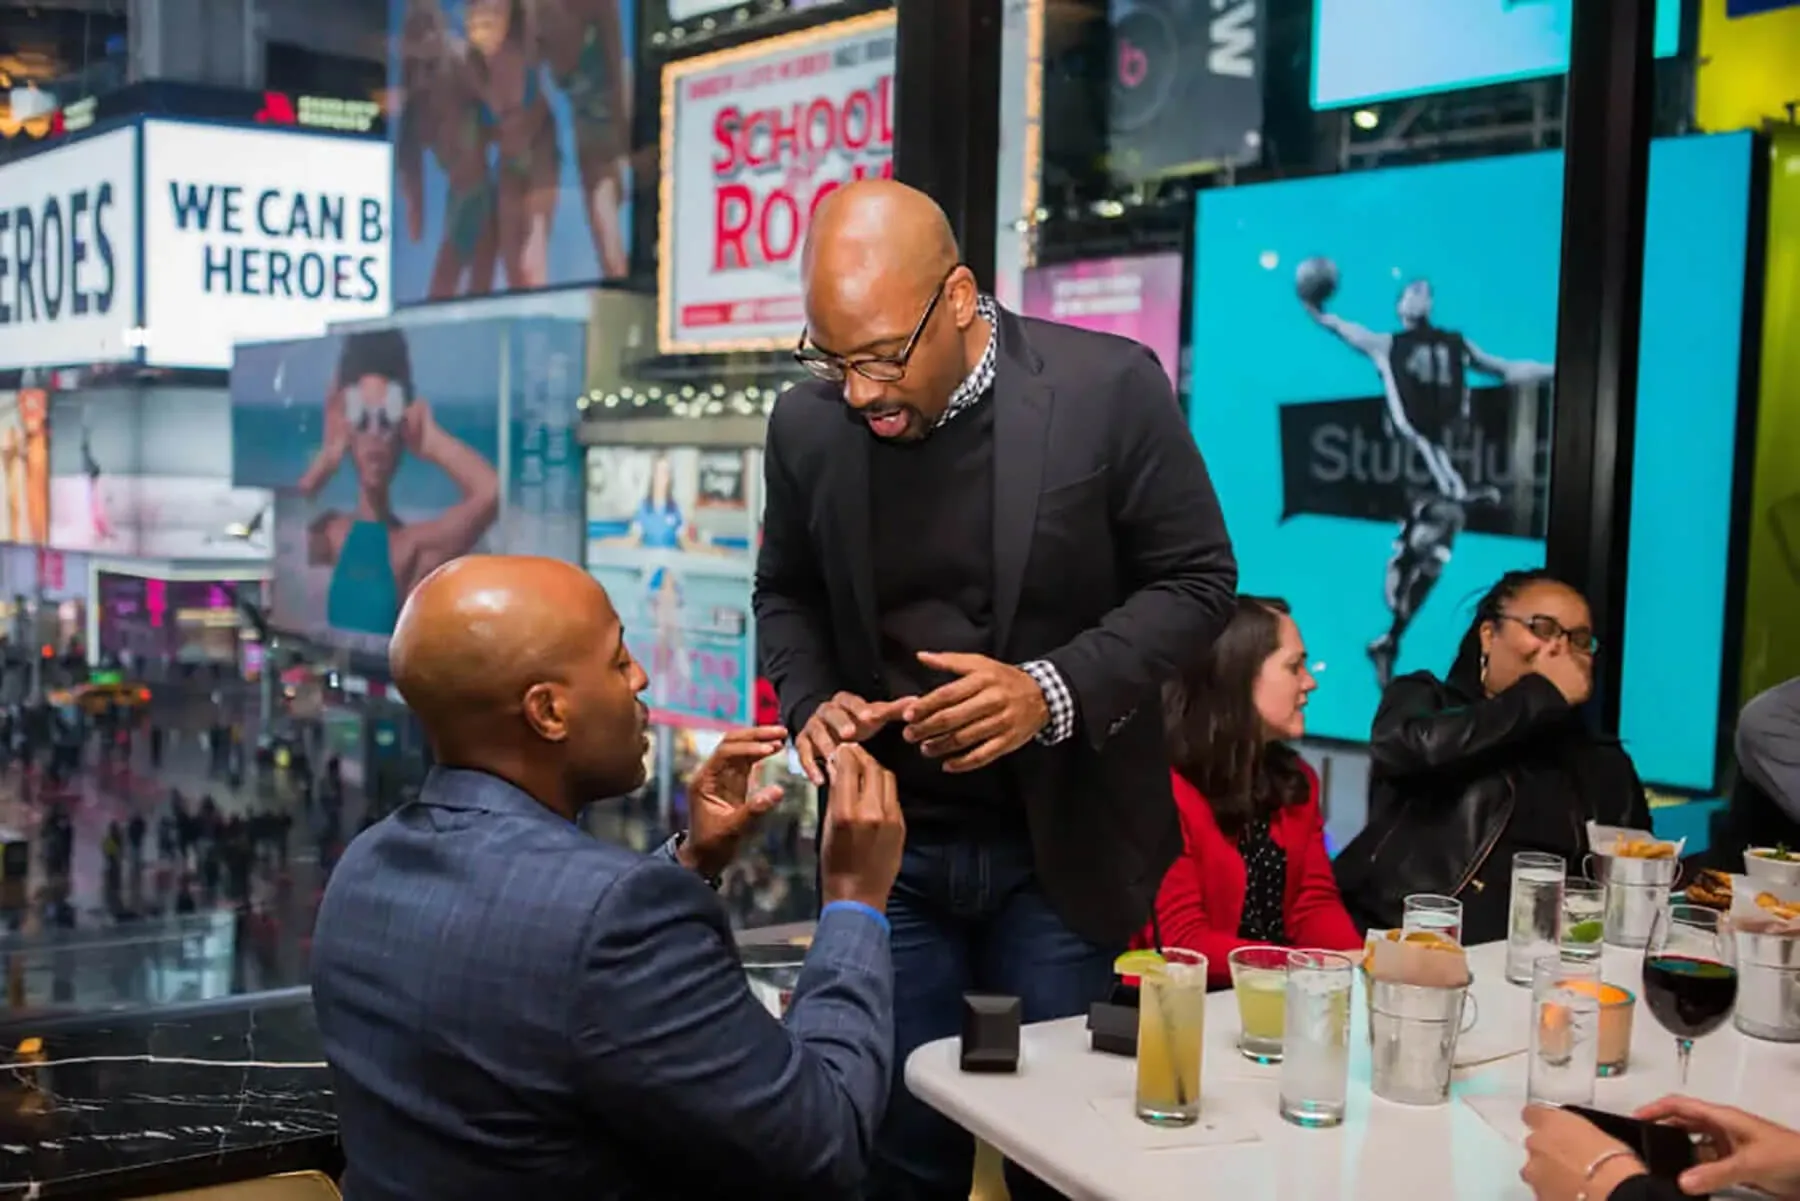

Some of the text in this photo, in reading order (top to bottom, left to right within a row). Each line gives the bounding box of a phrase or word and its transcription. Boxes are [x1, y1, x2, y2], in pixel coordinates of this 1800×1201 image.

[168, 180, 243, 233] WE
[256, 189, 345, 240] CAN
[203, 246, 379, 302] HEROES
[1405, 342, 1453, 387] 41
